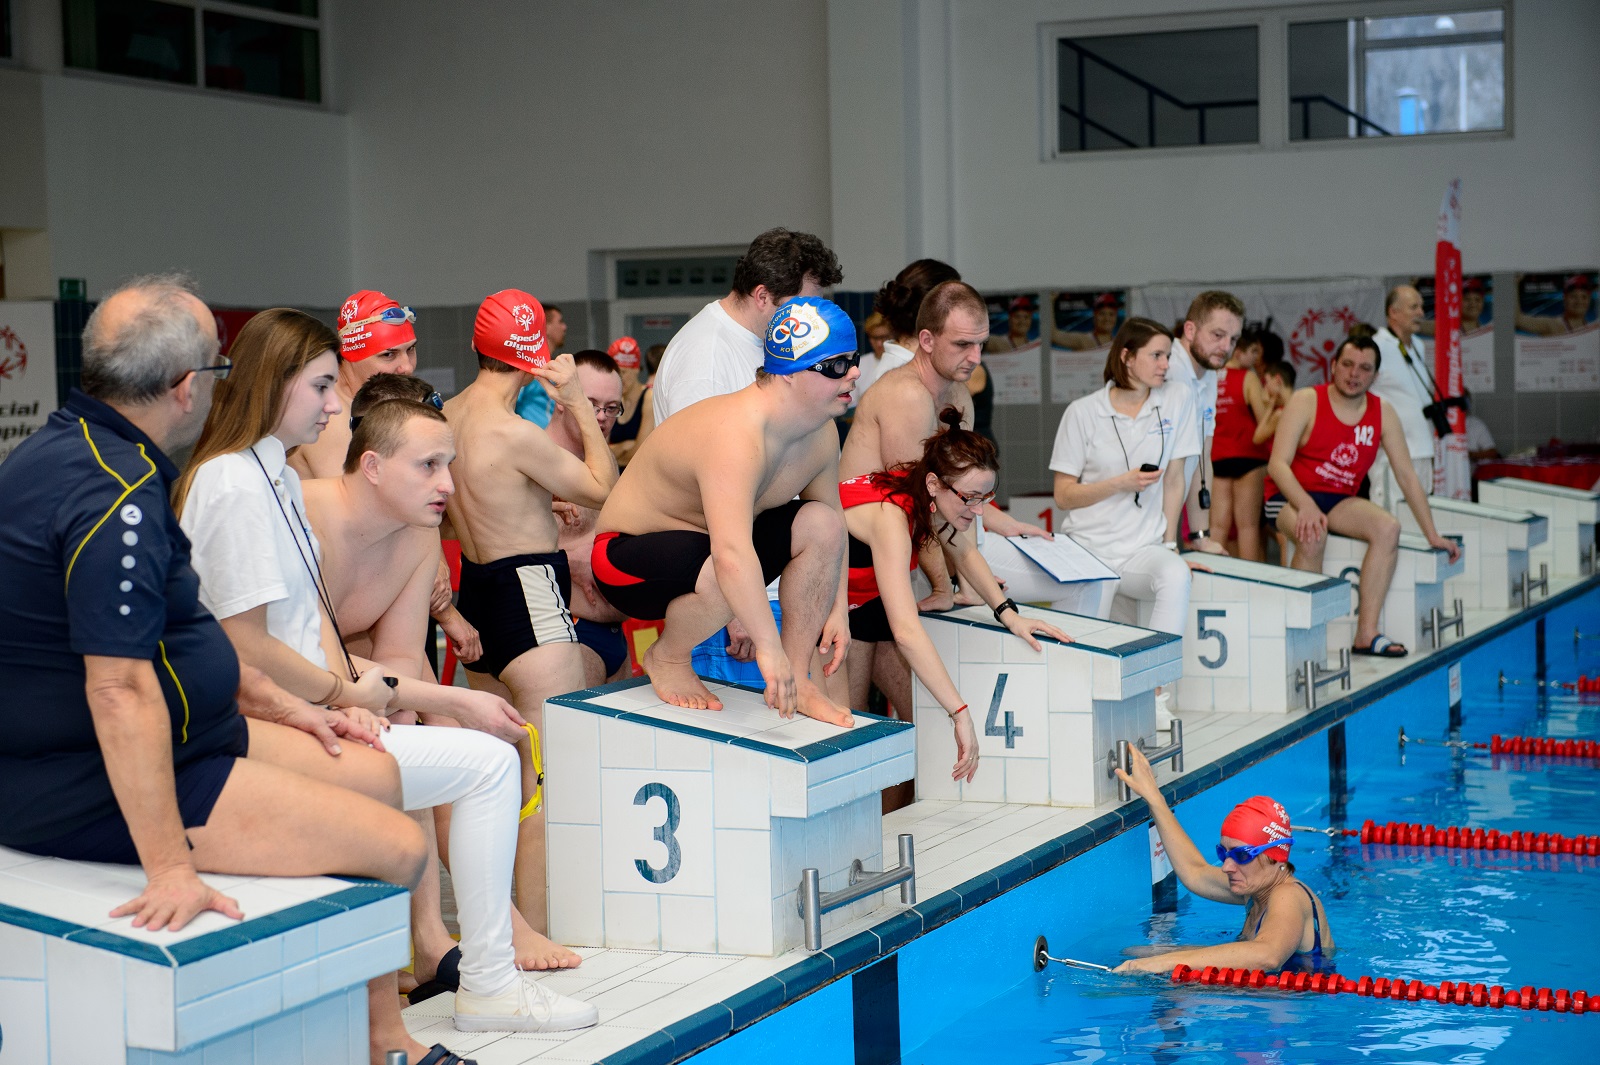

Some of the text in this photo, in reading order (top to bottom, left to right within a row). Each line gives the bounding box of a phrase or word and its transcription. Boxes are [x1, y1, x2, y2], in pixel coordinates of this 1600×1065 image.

[510, 329, 541, 343] Special
[1353, 425, 1374, 447] 142
[1038, 507, 1053, 533] 1
[1197, 609, 1228, 670] 5
[984, 672, 1024, 750] 4
[632, 781, 682, 885] 3
